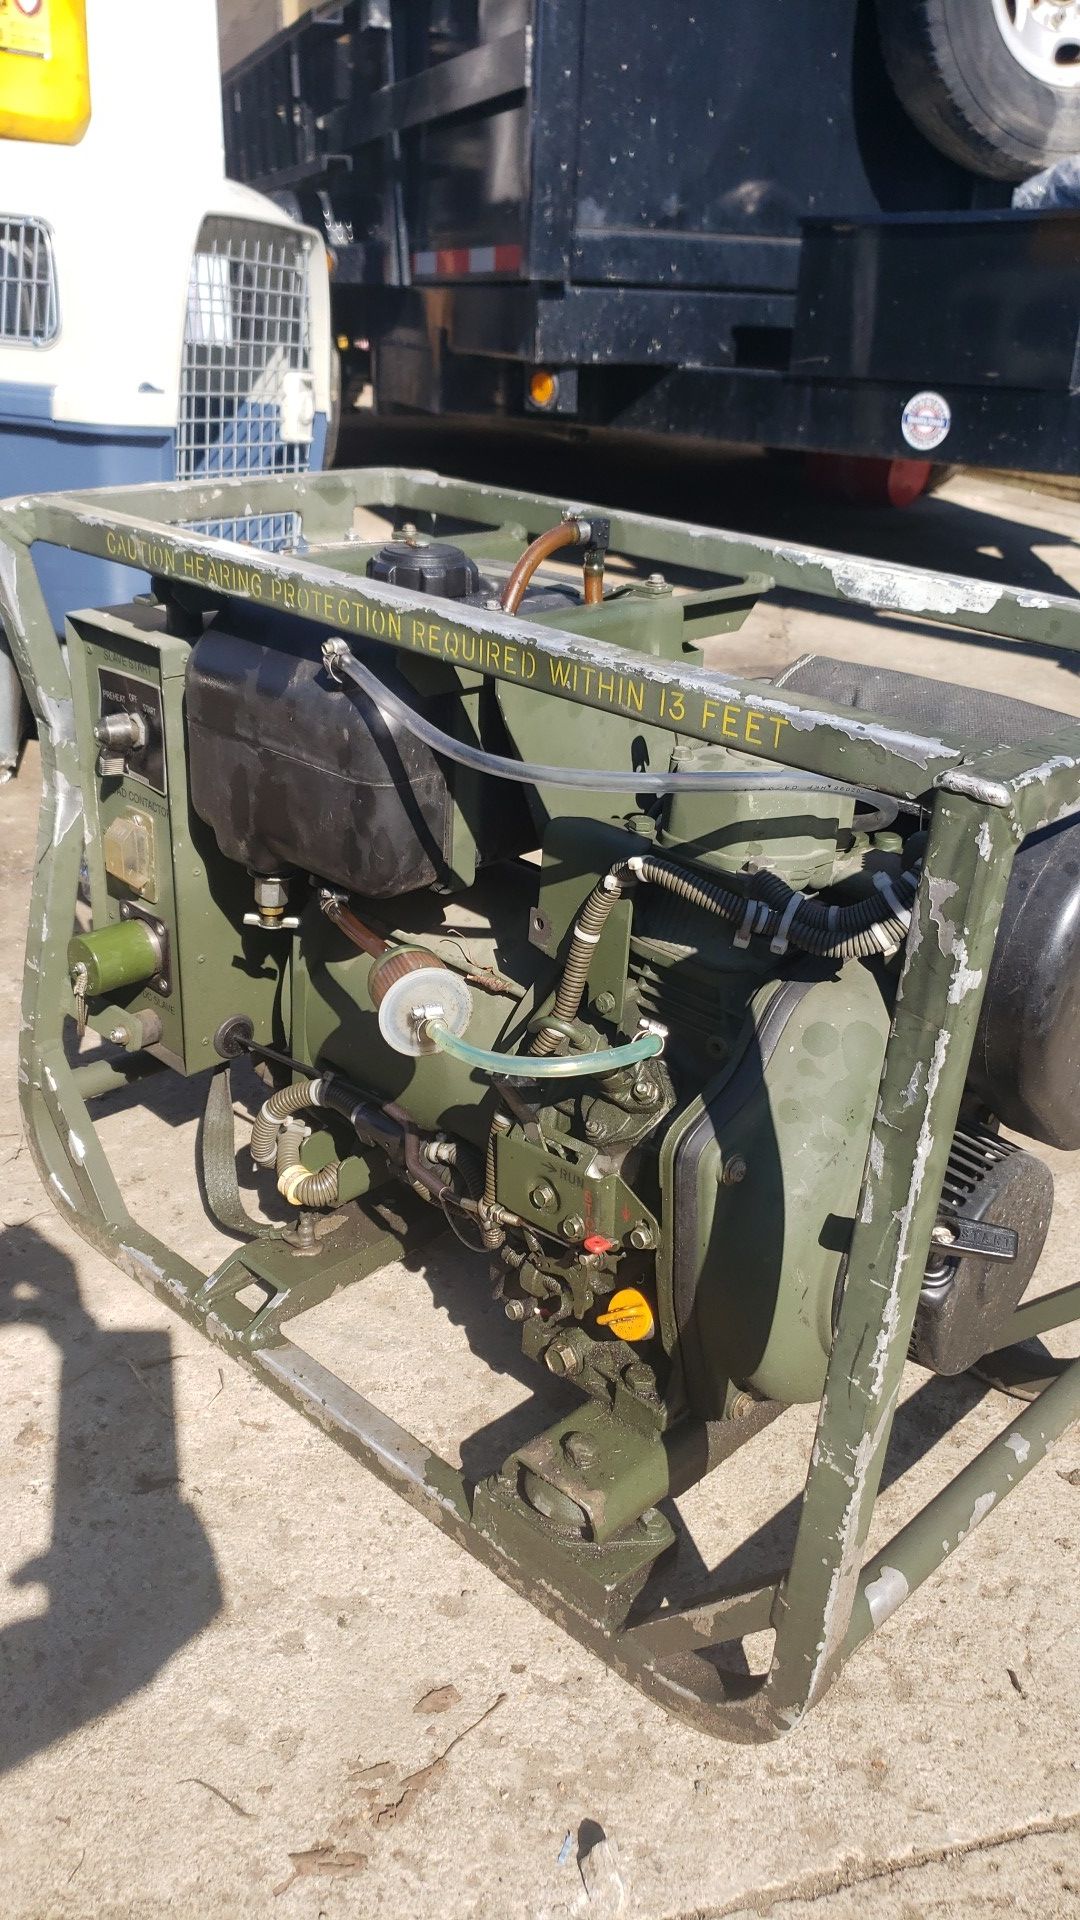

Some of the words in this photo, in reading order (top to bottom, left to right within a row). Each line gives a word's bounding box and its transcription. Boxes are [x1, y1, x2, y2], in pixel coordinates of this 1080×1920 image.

[105, 531, 175, 573] CAUTION
[183, 554, 262, 597] HEARING
[271, 579, 402, 641] PROTECTION
[412, 621, 537, 679] REQUIRED
[549, 660, 644, 712] WITHIN
[659, 687, 686, 721] 13
[702, 700, 789, 748] FEET
[102, 689, 125, 703] PREHEAT
[128, 692, 138, 703] OFF
[560, 1167, 584, 1189] RUN
[961, 1228, 1010, 1247] START
